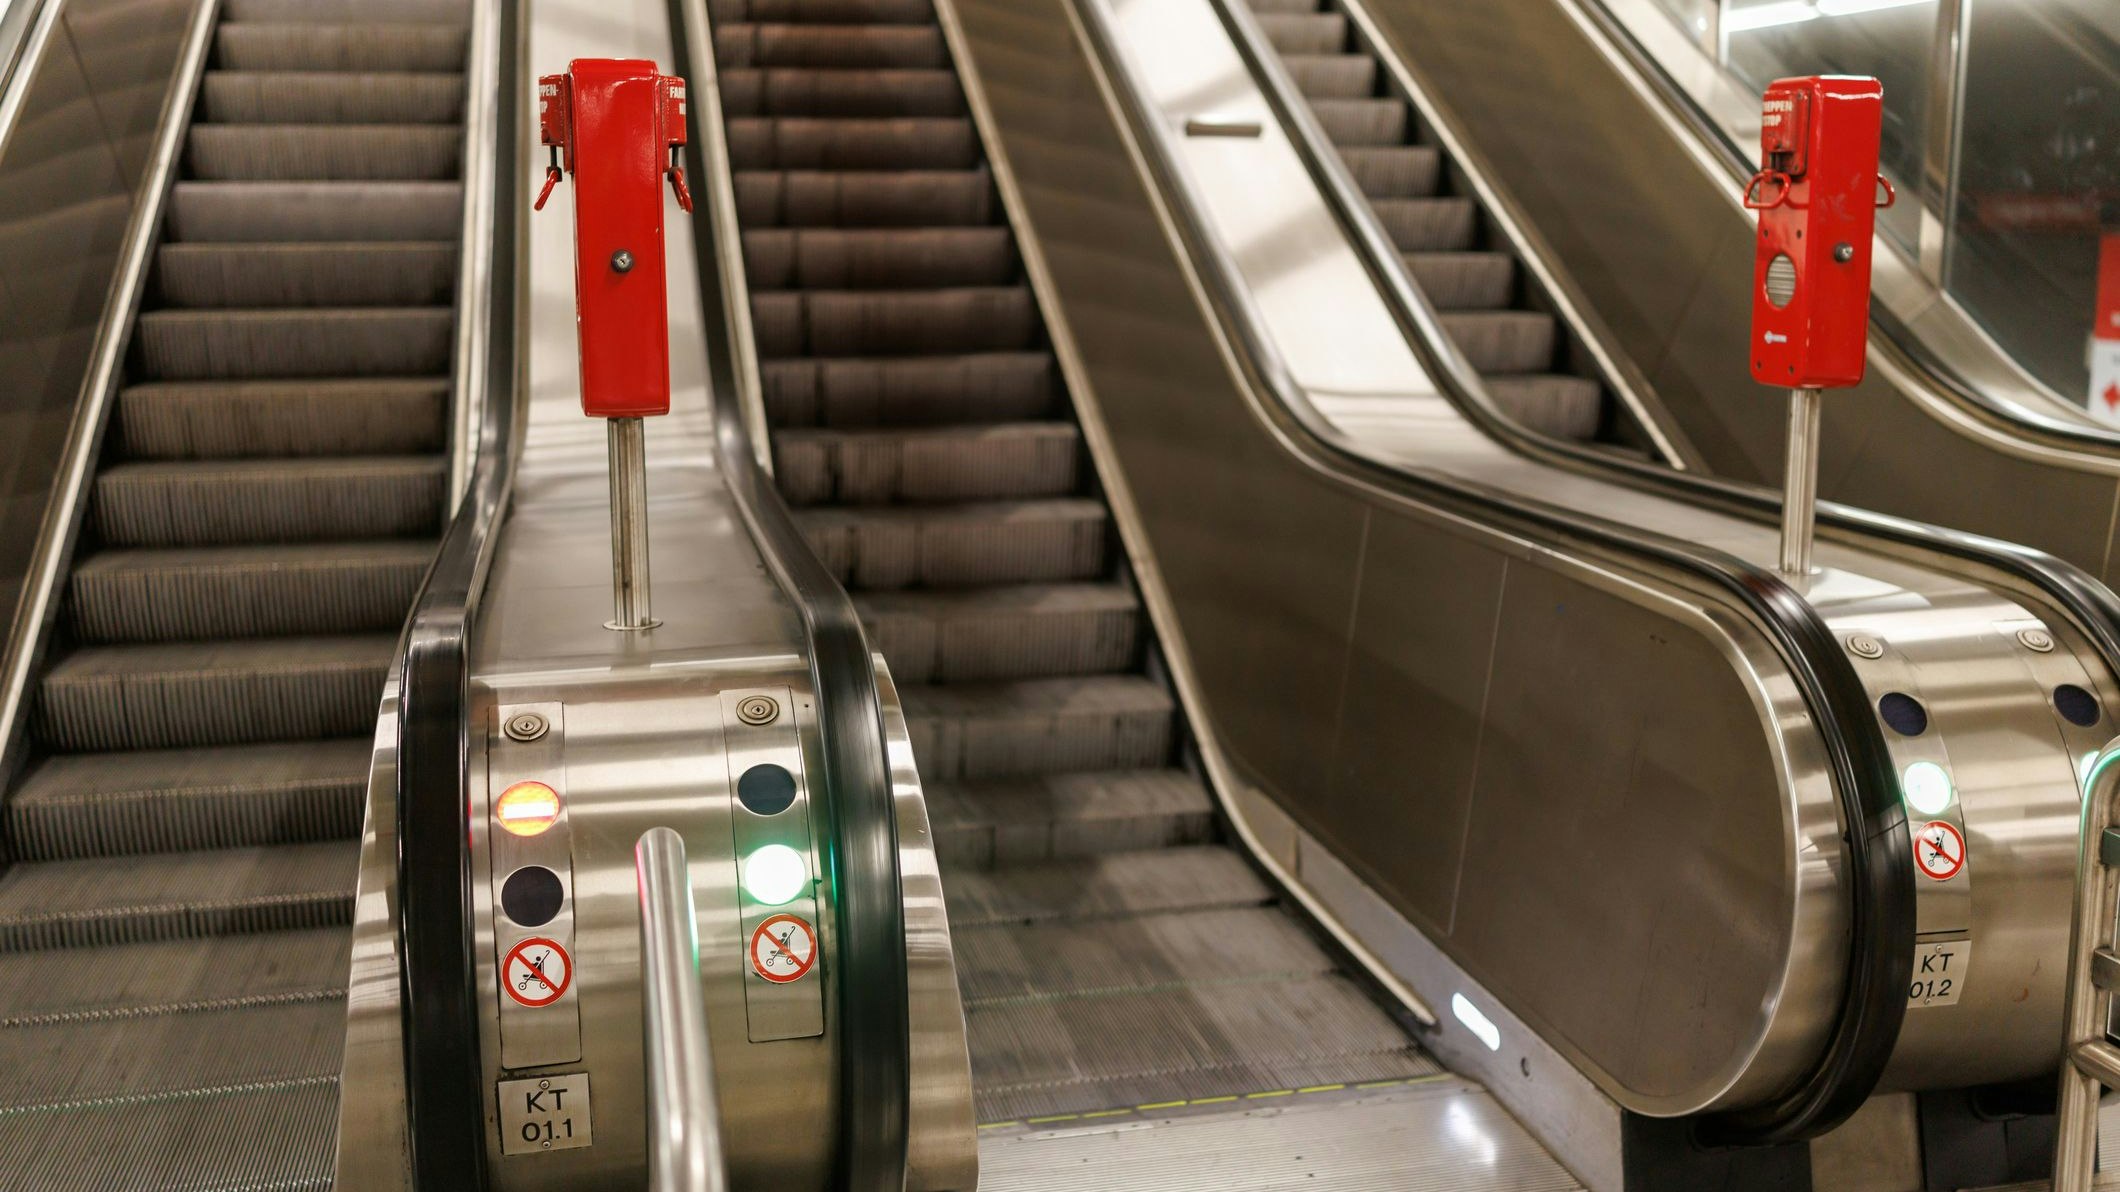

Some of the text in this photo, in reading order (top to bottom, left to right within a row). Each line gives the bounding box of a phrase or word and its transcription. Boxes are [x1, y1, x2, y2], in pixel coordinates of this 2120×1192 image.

[1921, 953, 1954, 973] KT
[1909, 979, 1952, 999] 01.2
[526, 1088, 568, 1113] KT
[521, 1118, 572, 1142] 01.1
